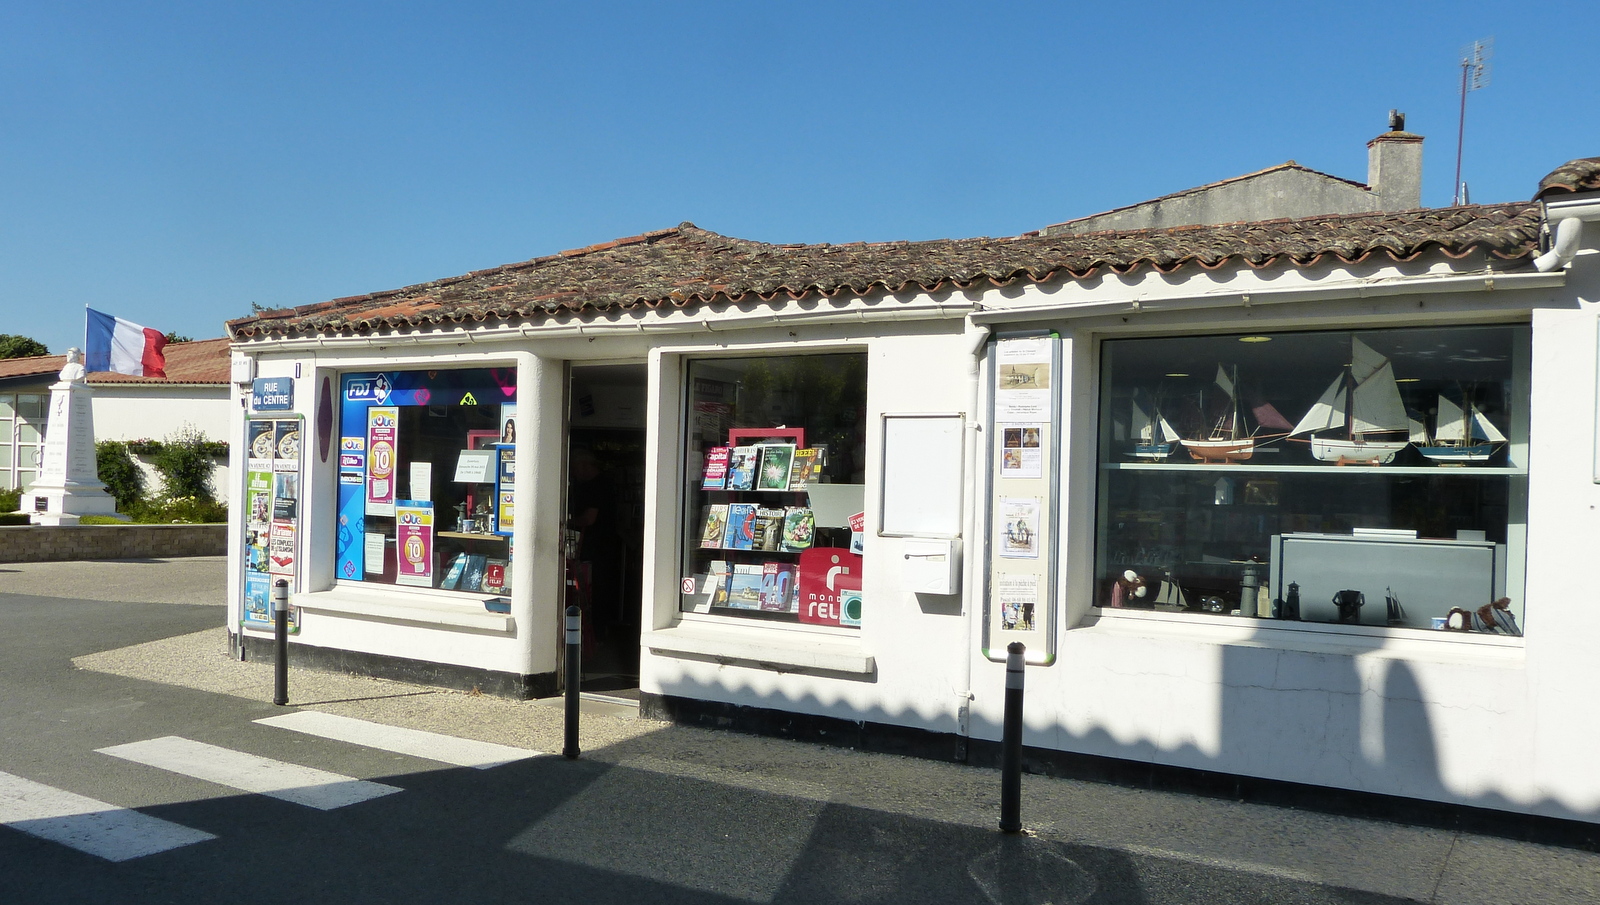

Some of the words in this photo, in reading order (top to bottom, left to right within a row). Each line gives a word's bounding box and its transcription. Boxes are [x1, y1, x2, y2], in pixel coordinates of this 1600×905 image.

[264, 382, 278, 392] RUE
[349, 383, 370, 396] FDJ
[253, 396, 262, 405] du
[263, 395, 288, 405] CENTRE
[372, 414, 395, 427] LOTO
[343, 440, 362, 450] LOTO
[374, 451, 390, 469] 10
[707, 453, 728, 461] Capital
[400, 513, 422, 525] LOTO
[409, 543, 421, 558] 10
[760, 571, 792, 604] 40
